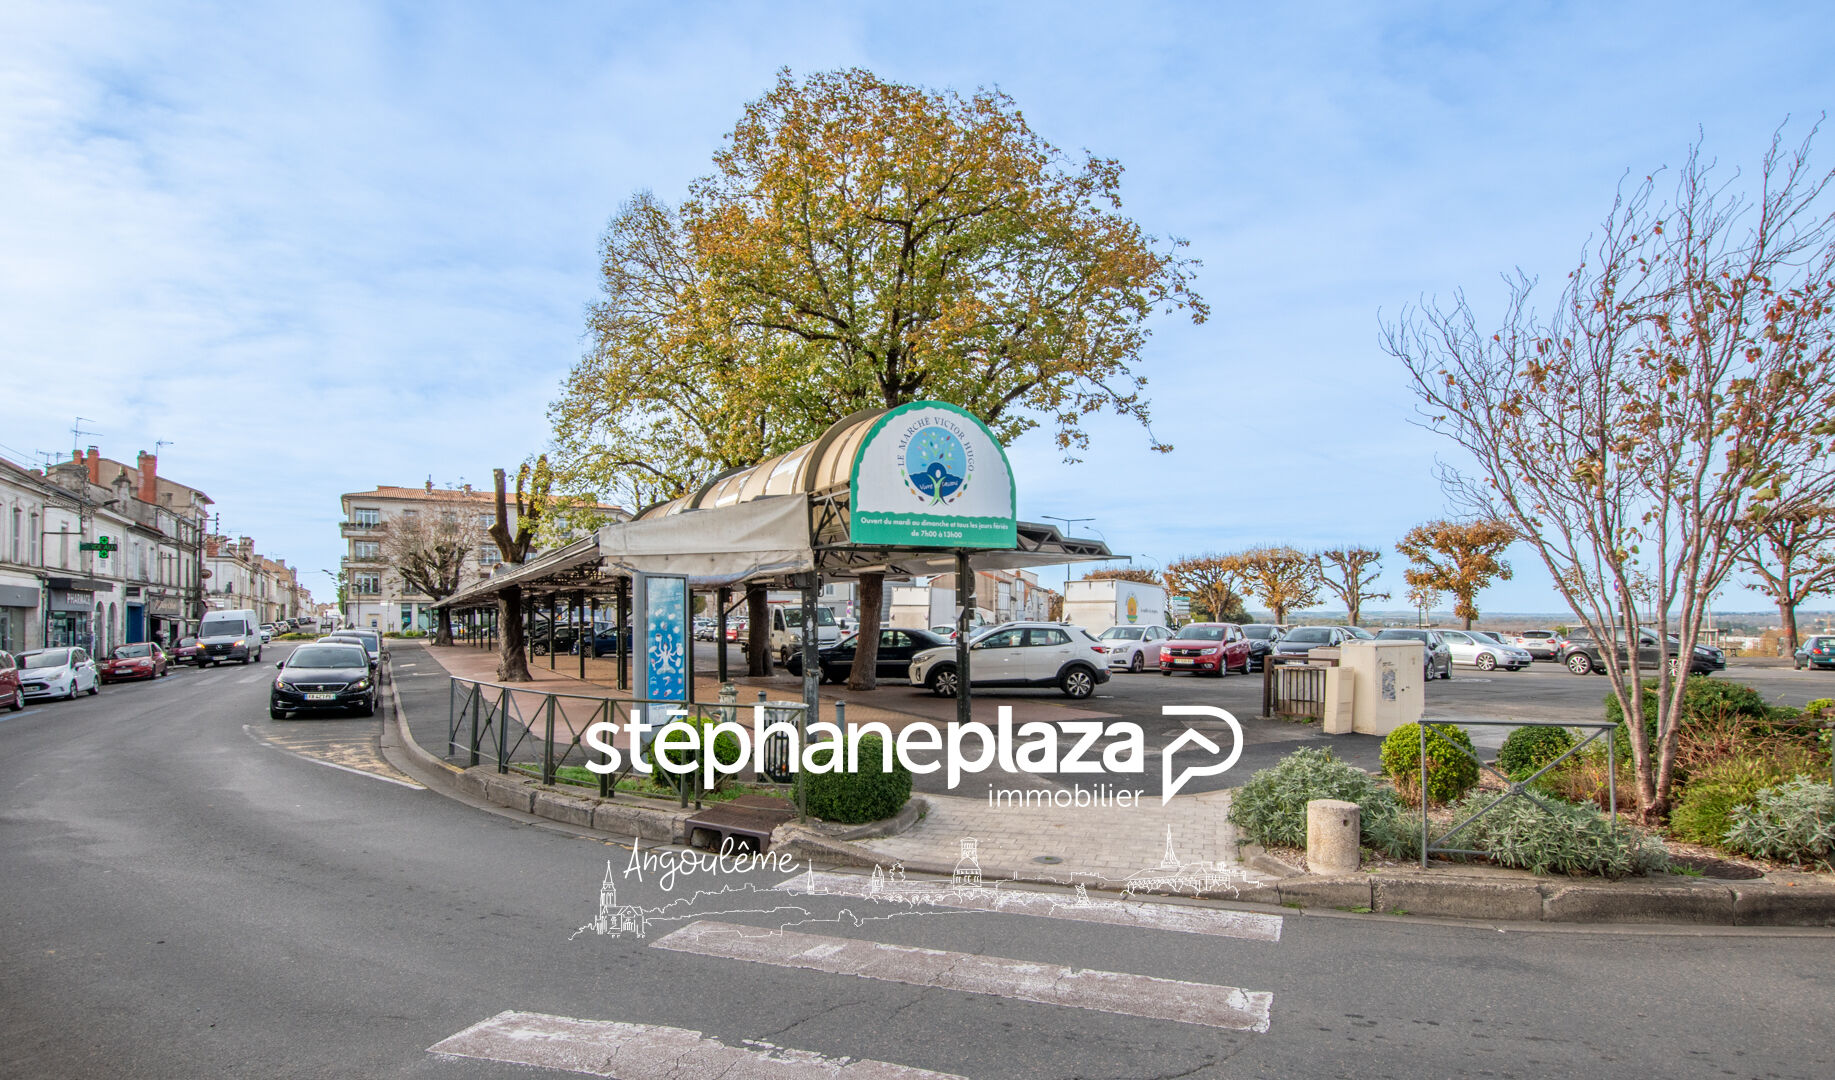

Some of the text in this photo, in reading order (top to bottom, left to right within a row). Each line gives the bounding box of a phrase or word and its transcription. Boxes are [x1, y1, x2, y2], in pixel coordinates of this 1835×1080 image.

[897, 416, 975, 472] LE MARCHÉ VICTOR HUGO
[860, 517, 883, 525] Ouvert
[883, 517, 892, 525] du
[893, 518, 911, 526] mardi
[921, 519, 949, 528] dimanche
[969, 521, 978, 529] les
[978, 522, 992, 530] jours
[921, 530, 937, 538] 7h00
